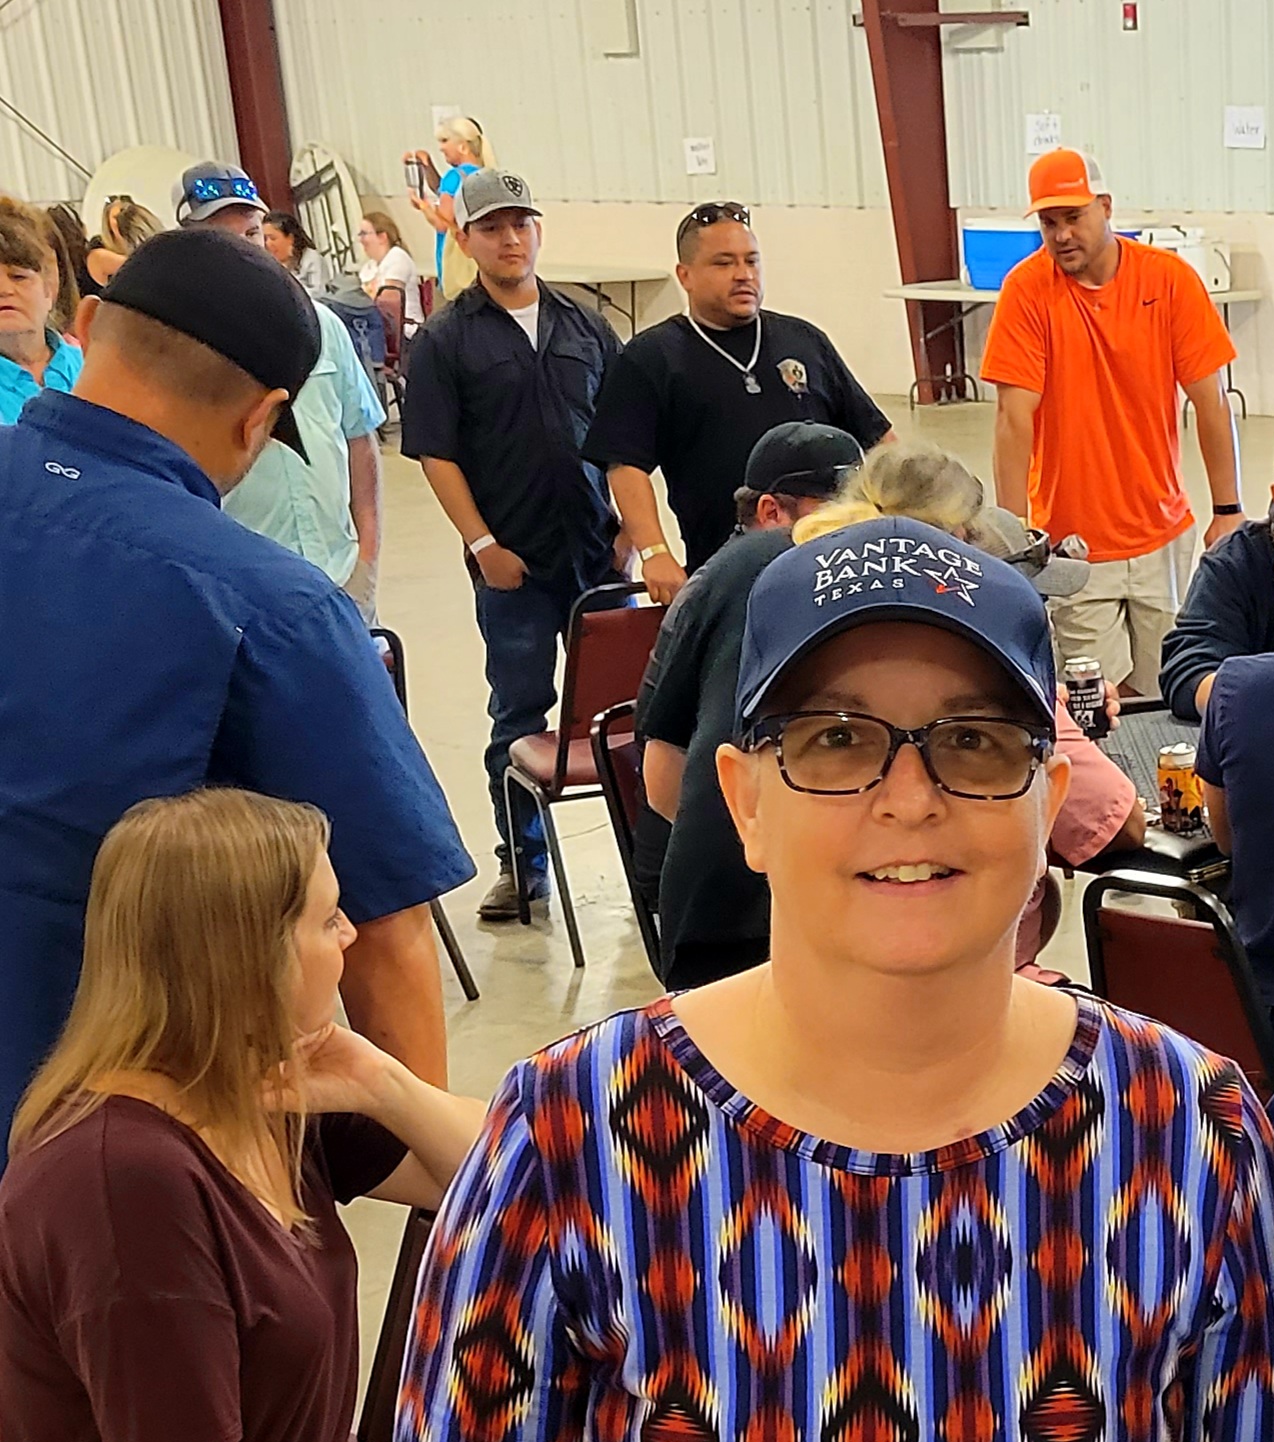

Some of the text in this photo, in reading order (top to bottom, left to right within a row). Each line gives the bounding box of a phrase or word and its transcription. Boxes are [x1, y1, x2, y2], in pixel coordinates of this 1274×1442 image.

[813, 556, 922, 592] BANK
[815, 538, 983, 577] VANTAGE
[813, 578, 905, 606] TEXAS
